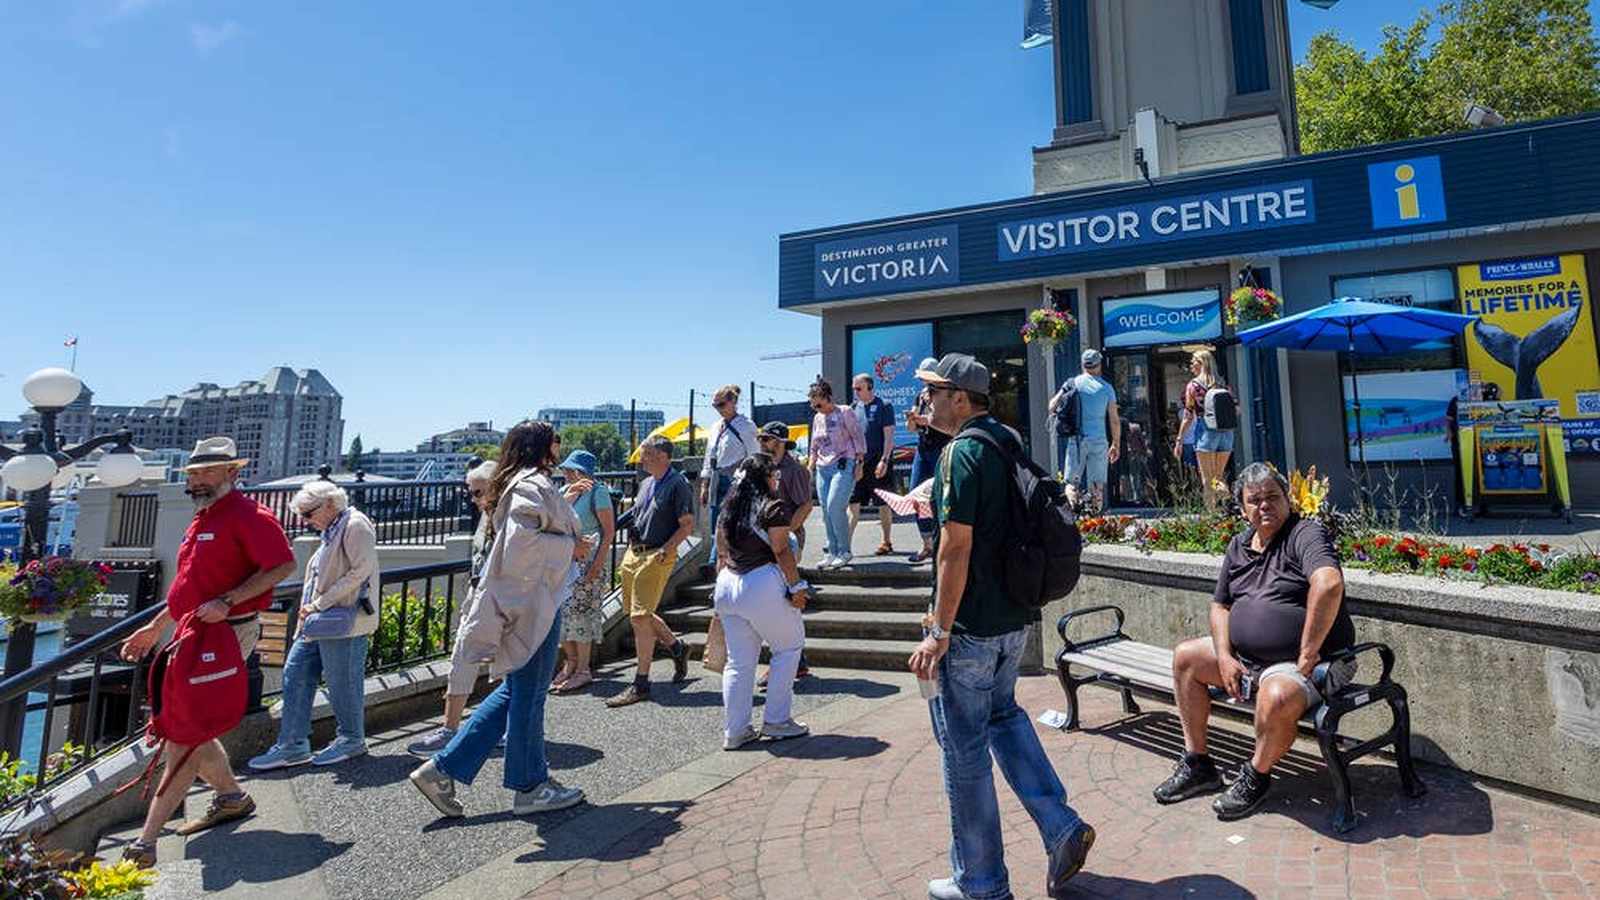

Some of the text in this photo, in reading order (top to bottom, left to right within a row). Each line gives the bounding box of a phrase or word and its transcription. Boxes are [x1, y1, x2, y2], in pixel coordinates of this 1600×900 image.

[1002, 187, 1307, 254] VISITOR CENTRE
[821, 237, 949, 262] DESTINATION GREATER
[821, 255, 950, 288] VICTORIA
[1464, 280, 1580, 299] MEMORIES FOR A
[1465, 290, 1582, 316] LIFETIME
[1119, 308, 1205, 328] WELCOME
